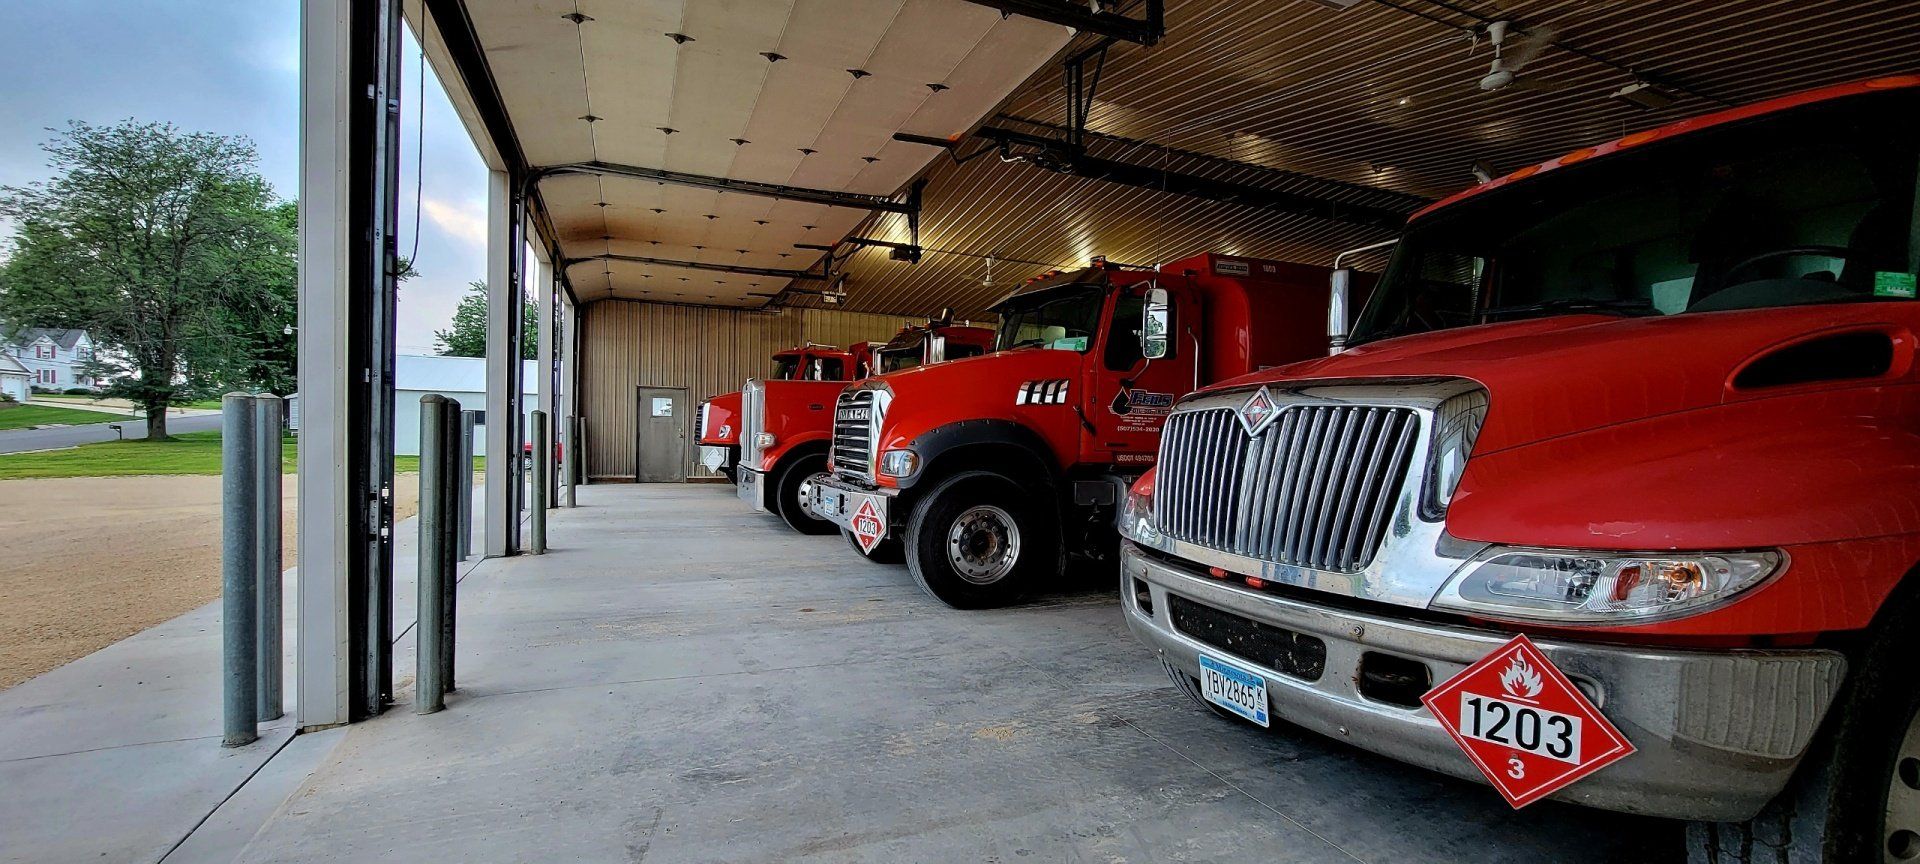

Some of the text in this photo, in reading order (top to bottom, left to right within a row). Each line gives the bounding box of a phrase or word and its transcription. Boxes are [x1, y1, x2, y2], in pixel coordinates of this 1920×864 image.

[1116, 454, 1134, 462] USDOT
[859, 519, 876, 535] 1203
[1466, 697, 1573, 759] 1203
[1507, 758, 1525, 780] 3
